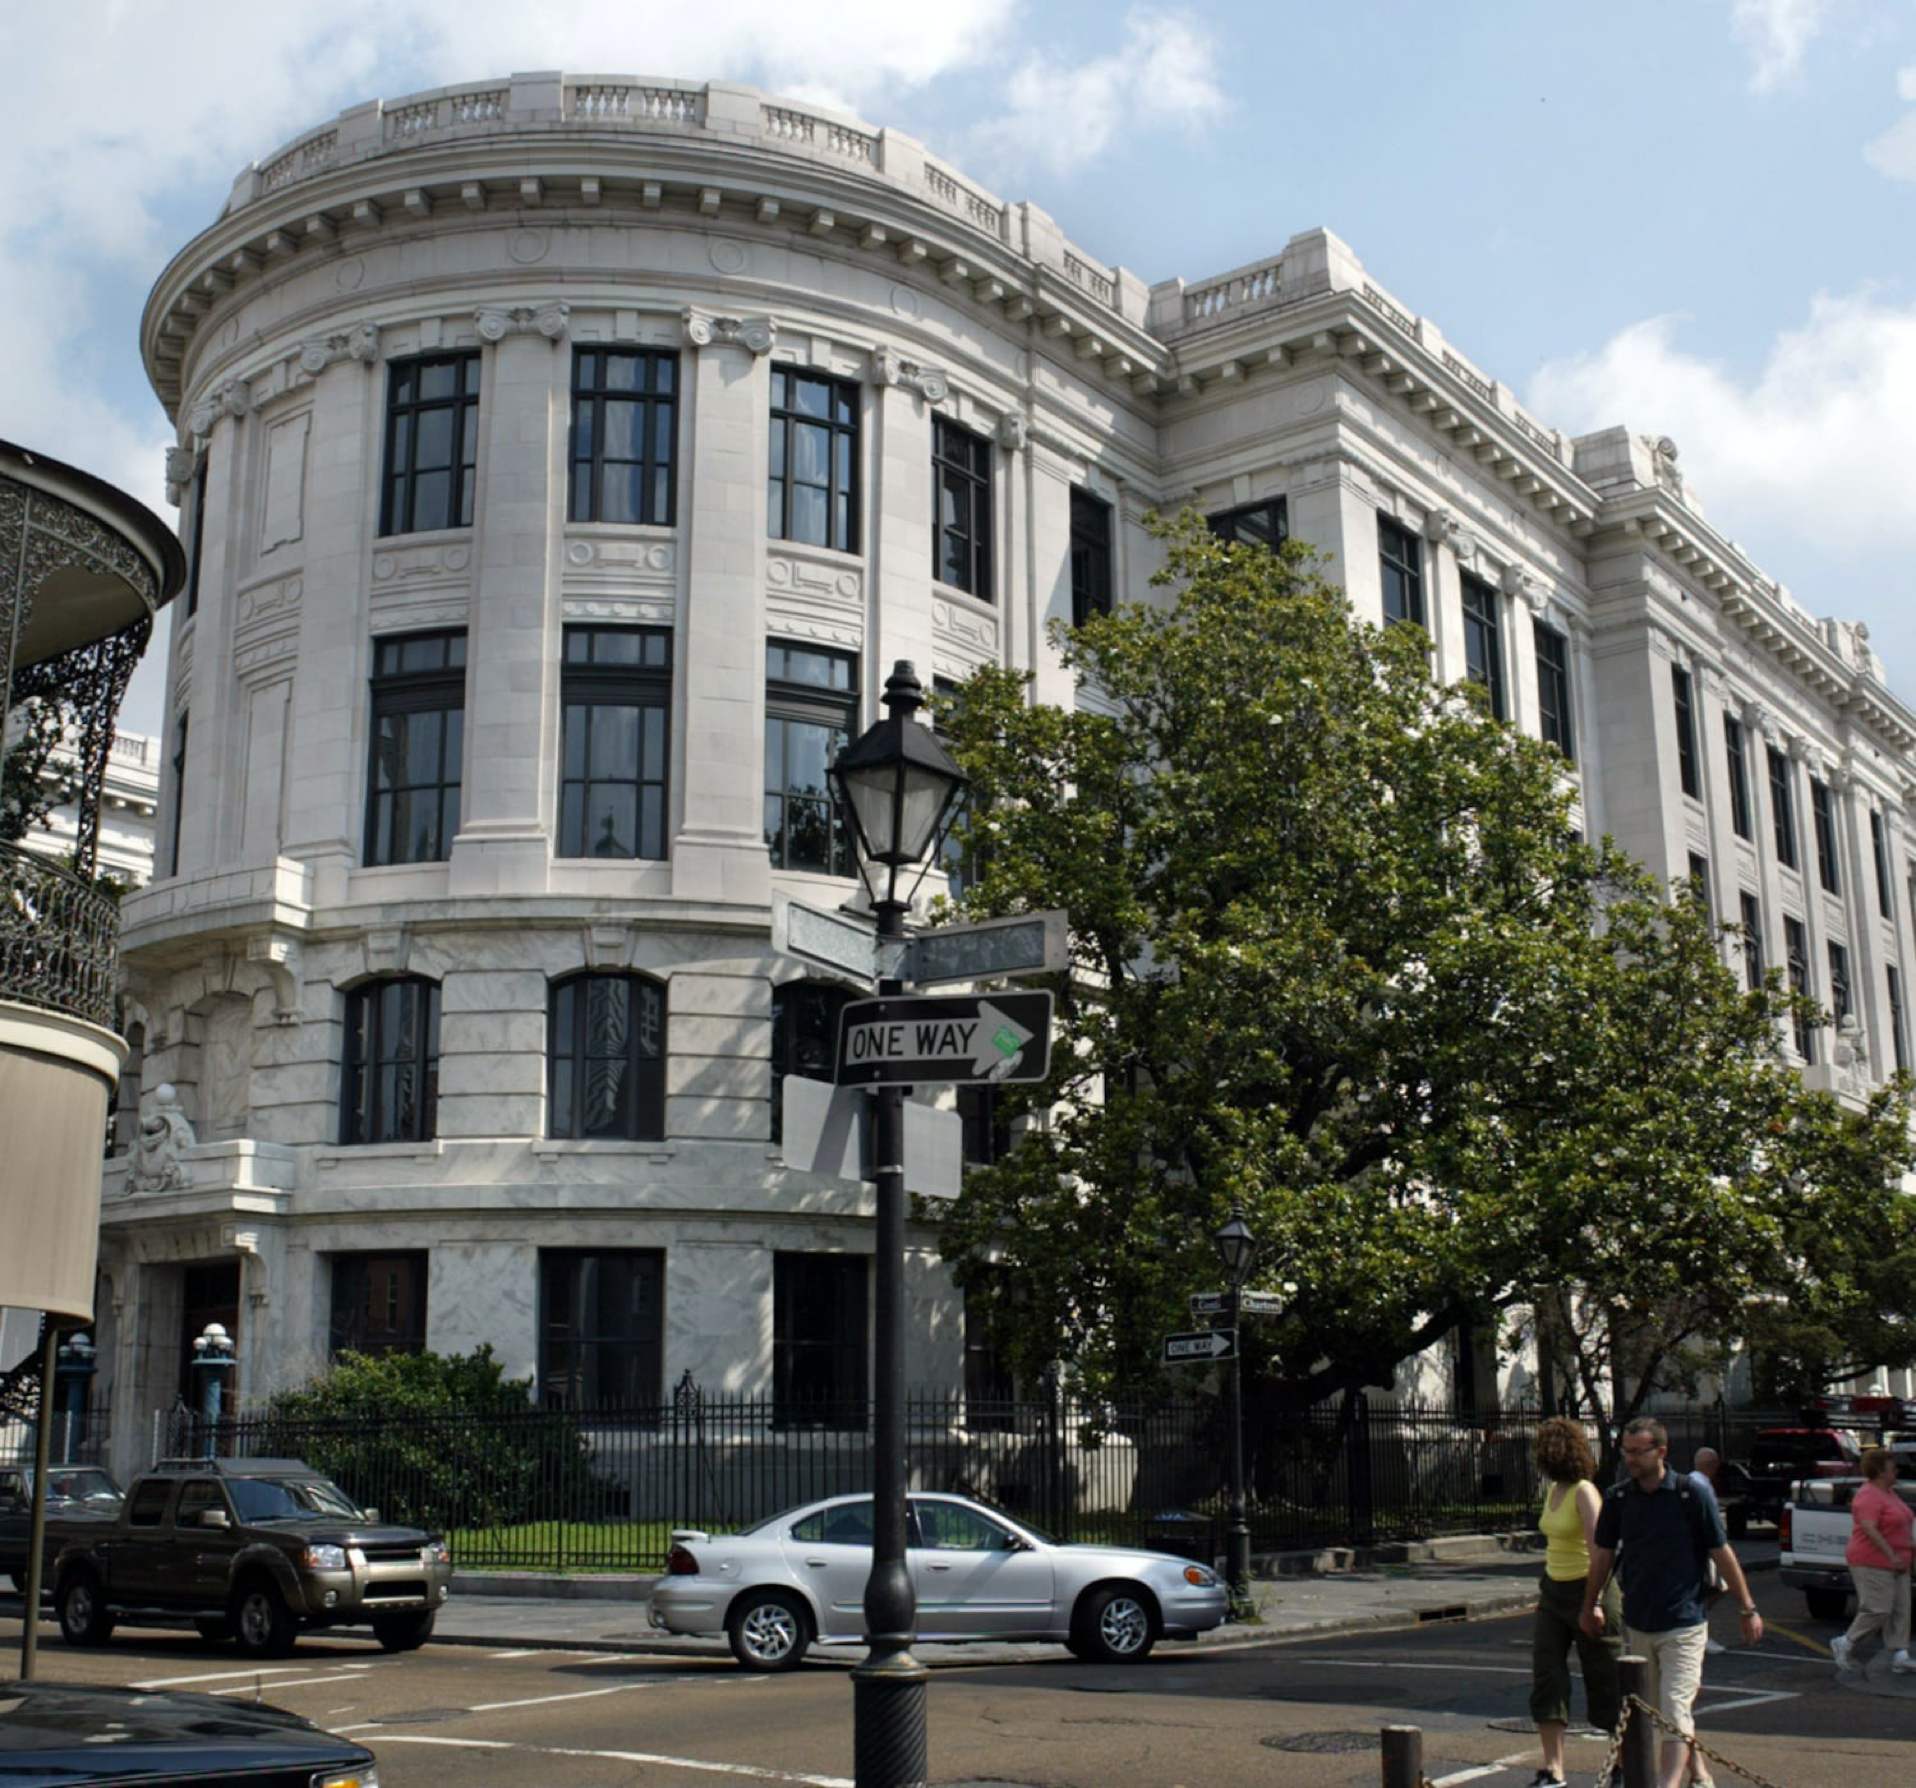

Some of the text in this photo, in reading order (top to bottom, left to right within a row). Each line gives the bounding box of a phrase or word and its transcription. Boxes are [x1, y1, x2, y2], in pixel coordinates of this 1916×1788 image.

[853, 1022, 979, 1059] ONE WAY
[1170, 1339, 1213, 1354] ONE WAY
